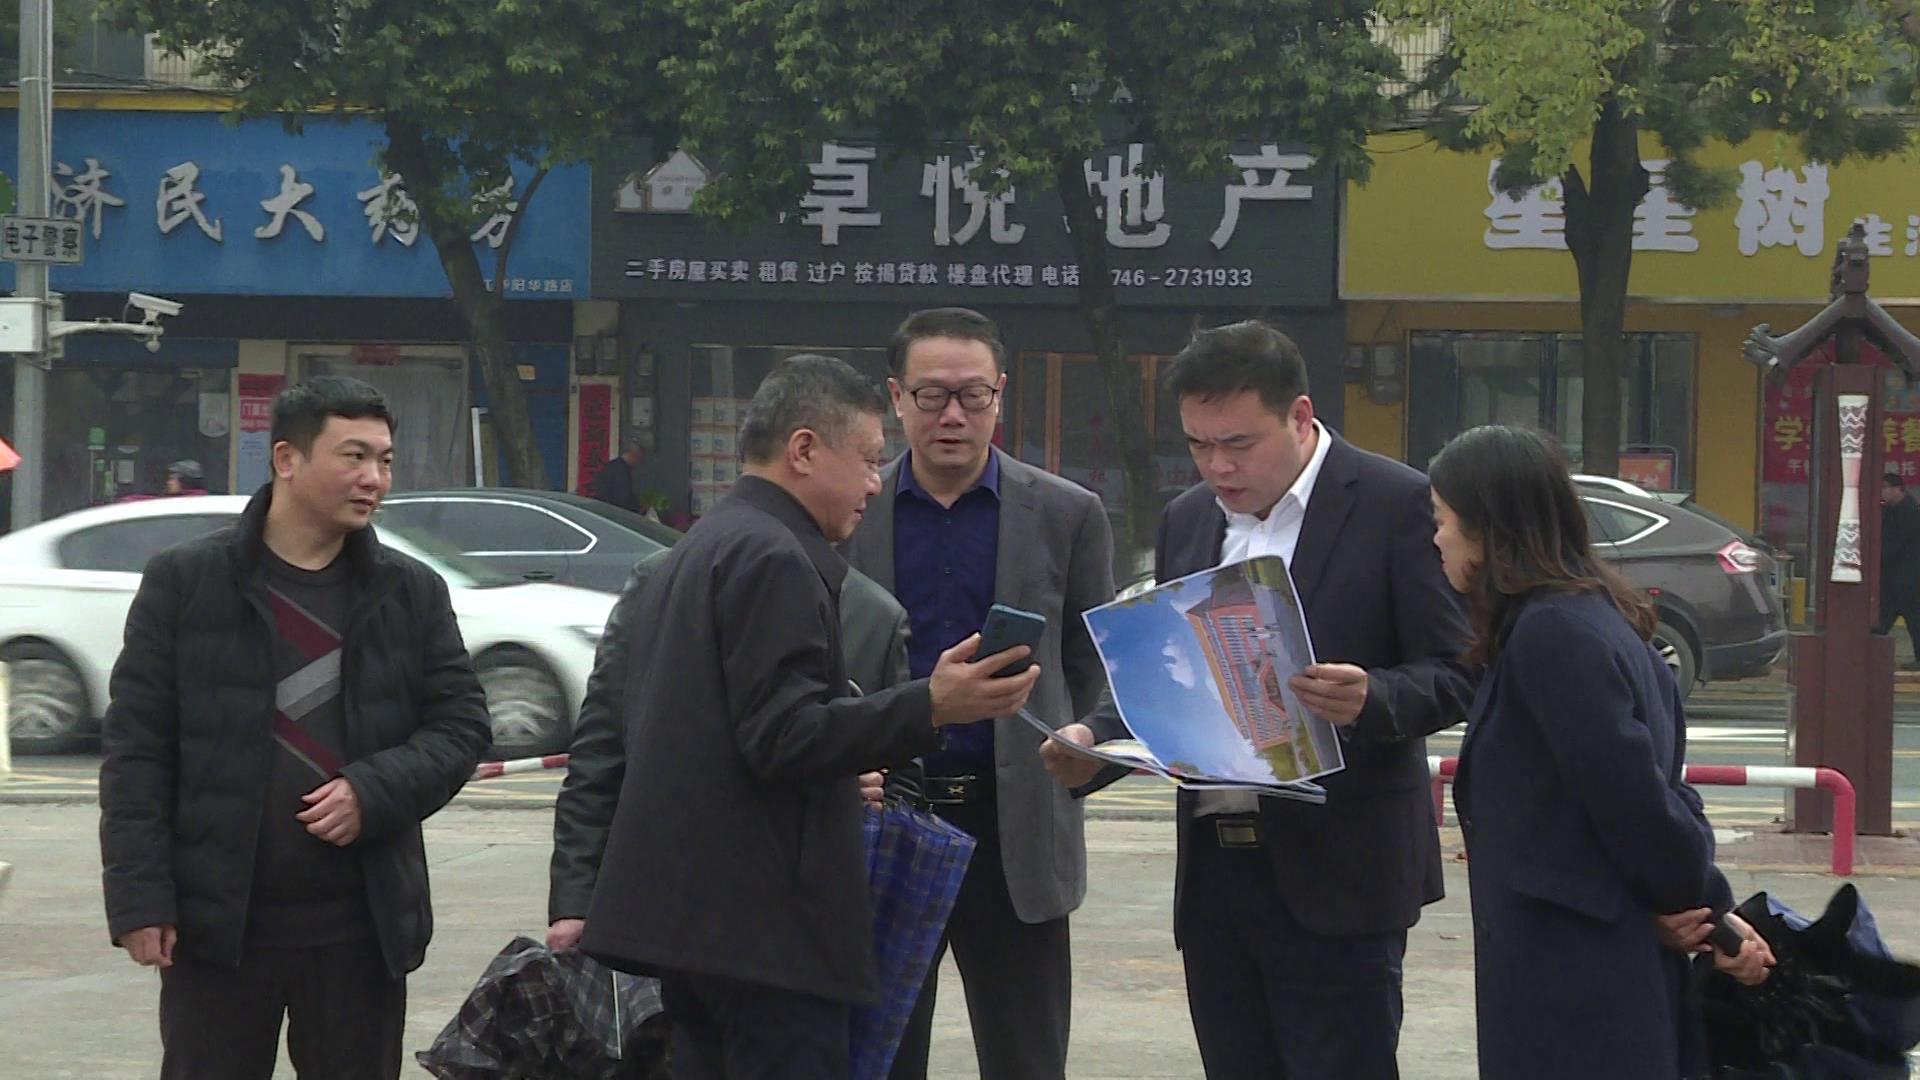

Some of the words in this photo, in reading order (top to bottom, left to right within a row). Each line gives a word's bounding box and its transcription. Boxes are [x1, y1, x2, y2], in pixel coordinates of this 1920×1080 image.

[778, 142, 1318, 250] 卓悦地产
[5, 222, 80, 257] 电子警察
[1855, 213, 1920, 256] 生
[625, 258, 750, 283] 二手房屋买卖
[758, 261, 799, 283] 租赁
[807, 262, 847, 284] 过户
[854, 262, 939, 285] 按揭贷款
[947, 263, 1034, 287] 楼盘代理
[1041, 264, 1081, 287] 电话
